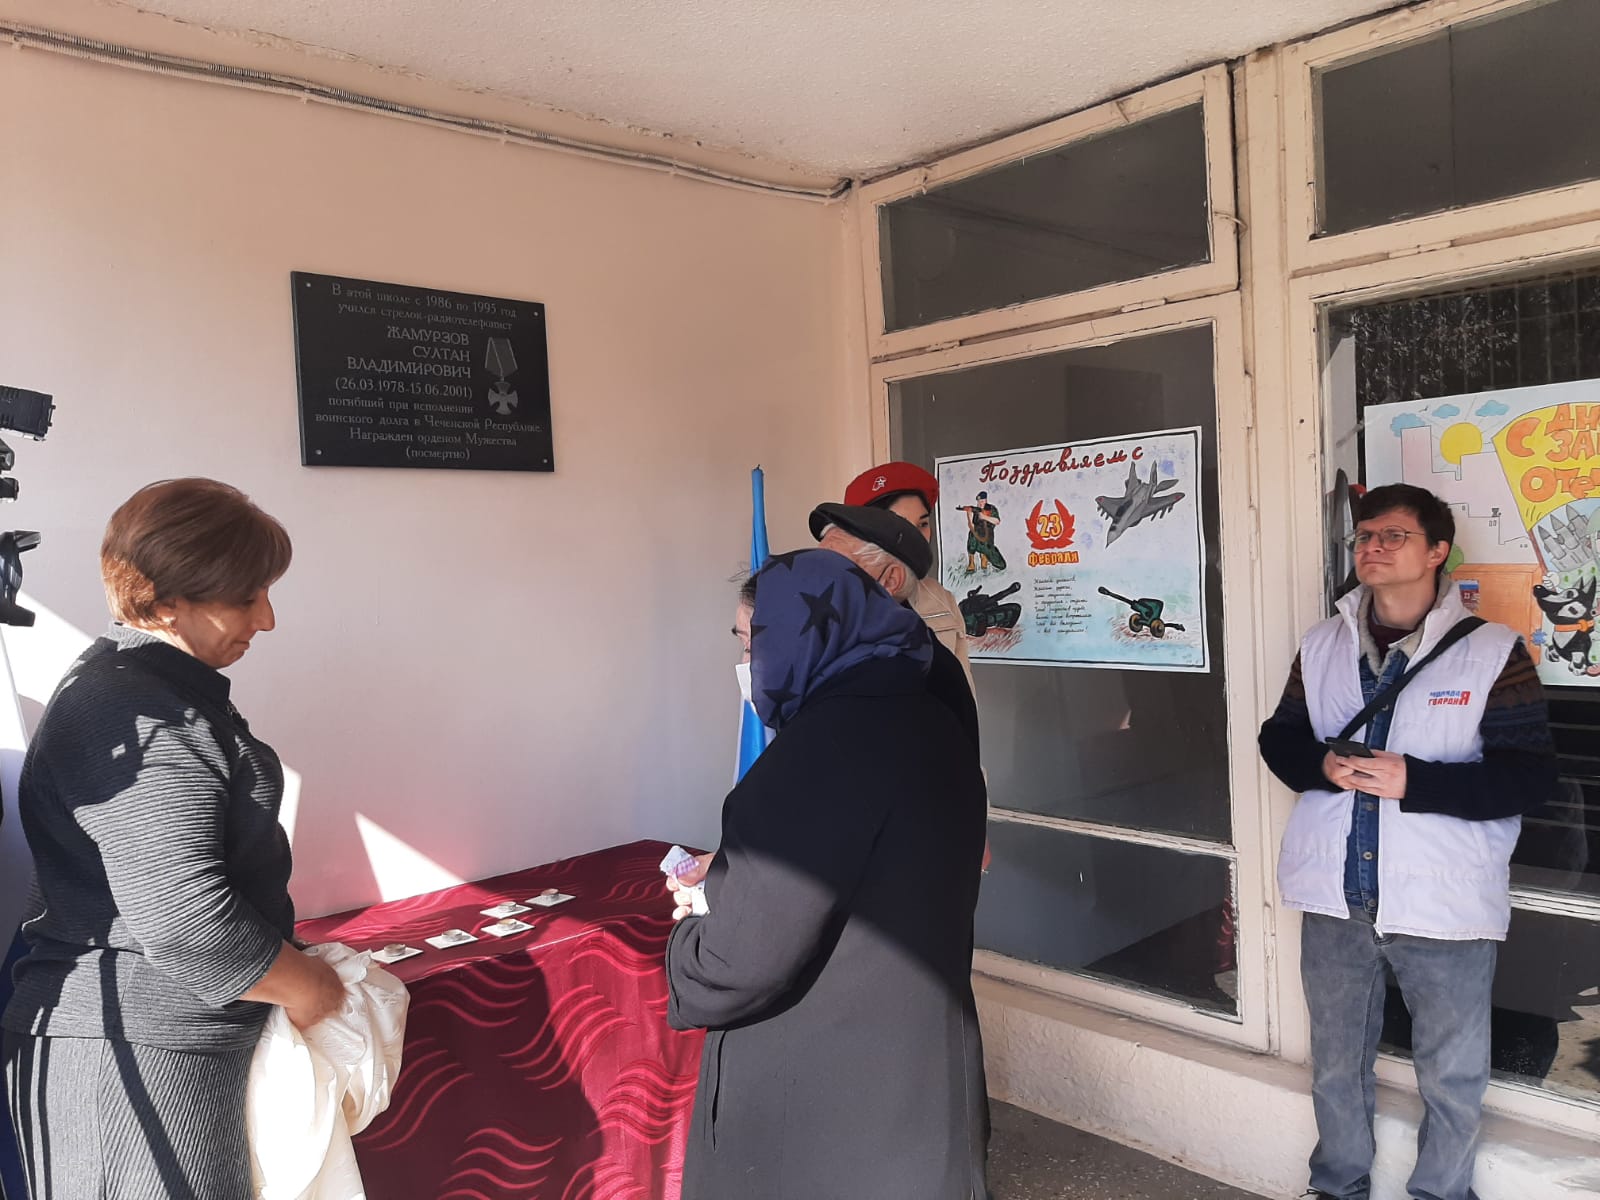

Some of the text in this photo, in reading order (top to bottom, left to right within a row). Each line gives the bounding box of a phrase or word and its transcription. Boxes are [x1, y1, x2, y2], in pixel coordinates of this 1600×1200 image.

[332, 284, 341, 296] В
[347, 288, 372, 301] этой
[377, 292, 411, 305] школе
[415, 297, 421, 306] с
[426, 295, 452, 310] 1986
[457, 303, 469, 312] по
[473, 301, 497, 316] 1995
[338, 303, 376, 315] учился
[387, 325, 470, 346] ЖАМУРЗОВ
[412, 345, 471, 362] СУЛТАН
[347, 356, 471, 378] ВЛАДИМИРОВИЧ
[328, 396, 473, 414] погибший при исполнении
[315, 412, 373, 424] воинского
[379, 416, 409, 427] долга
[414, 418, 421, 426] в
[424, 415, 480, 430] Чеченской
[350, 427, 517, 447] Награжден орденом Мужества
[1545, 430, 1600, 462] ЗА
[406, 446, 470, 461] (посмертно)
[979, 447, 1127, 487] Поздравляем
[1038, 513, 1063, 538] 23
